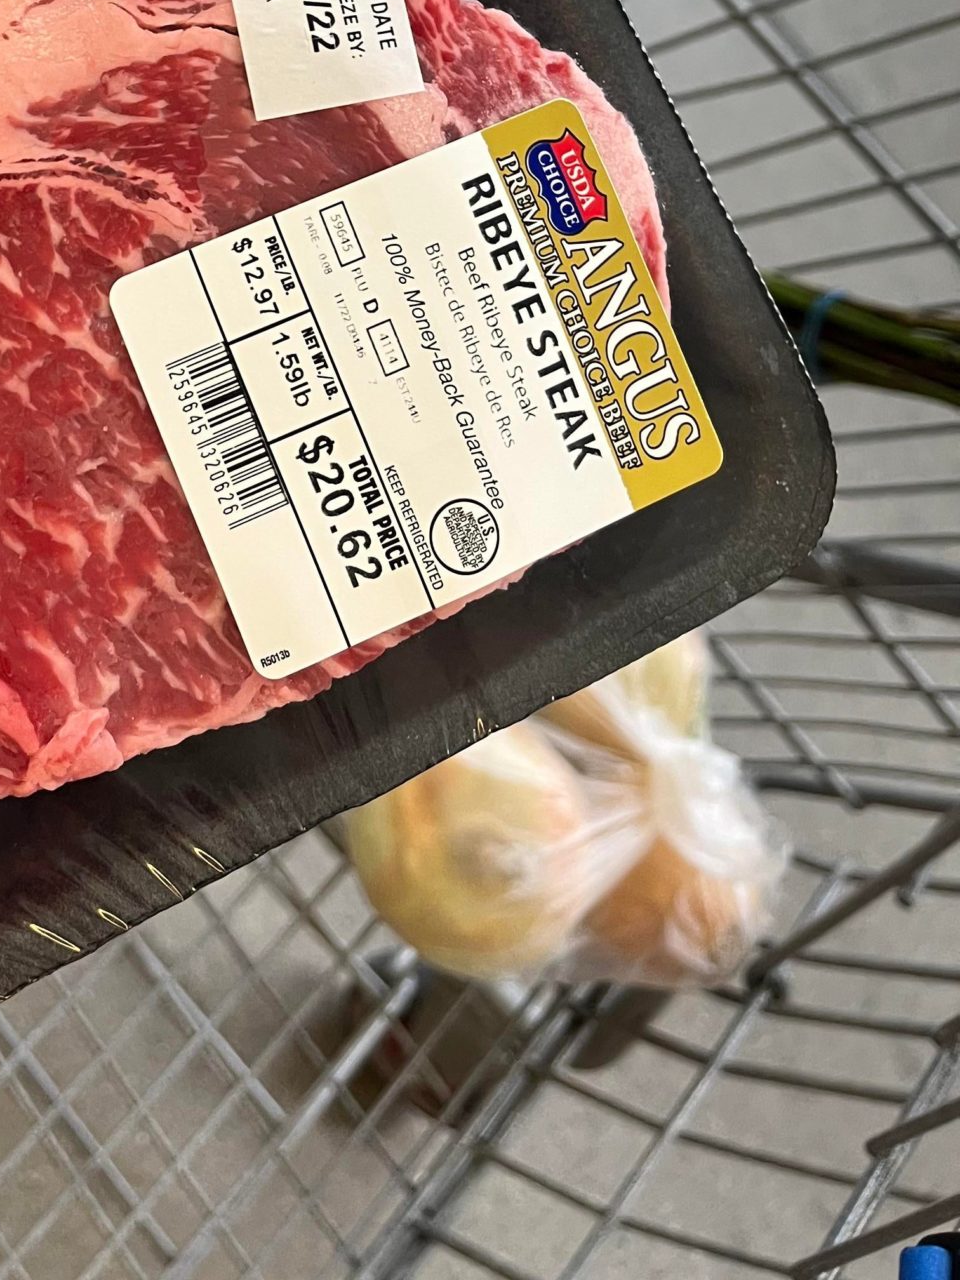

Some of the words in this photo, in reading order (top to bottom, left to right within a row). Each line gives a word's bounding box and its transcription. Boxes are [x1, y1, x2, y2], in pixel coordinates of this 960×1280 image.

[346, 30, 366, 59] BY:
[370, 1, 398, 51] DATE
[537, 150, 580, 228] CHOICE
[561, 149, 596, 211] USDA
[231, 237, 280, 315] $12.97
[264, 235, 296, 296] PRICE/LB.
[351, 266, 369, 292] PLU
[362, 297, 379, 314] D
[424, 242, 453, 297] Bistec
[447, 299, 466, 323] de
[458, 324, 491, 386] Ribeye
[485, 390, 503, 414] de
[495, 415, 514, 449] Res
[457, 246, 490, 291] Beef
[477, 293, 513, 362] Ribeye
[506, 365, 538, 421] Steak
[461, 172, 547, 325] RIBEYE
[526, 329, 603, 471] STEAK
[495, 150, 571, 291] PREMIUM
[555, 289, 616, 402] CHOICE
[598, 400, 645, 472] BEEF
[561, 236, 701, 461] ANGUS
[271, 332, 312, 407] 1.59lb
[300, 326, 321, 351] NET
[311, 351, 339, 401] WT./LB.
[381, 233, 415, 285] 100%
[403, 289, 465, 407] Money-Back
[455, 410, 504, 510] Guarantee
[168, 368, 208, 436] 259645
[200, 447, 240, 516] 320626
[295, 434, 383, 589] $20.62
[348, 454, 385, 515] TOTAL
[372, 514, 410, 571] PRICE
[383, 464, 406, 497] KEEP
[398, 498, 444, 591] REFRIGERATED
[443, 515, 471, 568] AGRICULTURE
[448, 508, 474, 558] DEPARTMENT
[469, 558, 479, 569] OF
[455, 506, 468, 523] AND
[475, 553, 485, 565] BY
[465, 511, 488, 554] INSPECTED
[477, 513, 498, 541] U.S.
[260, 649, 291, 669] R5013b
